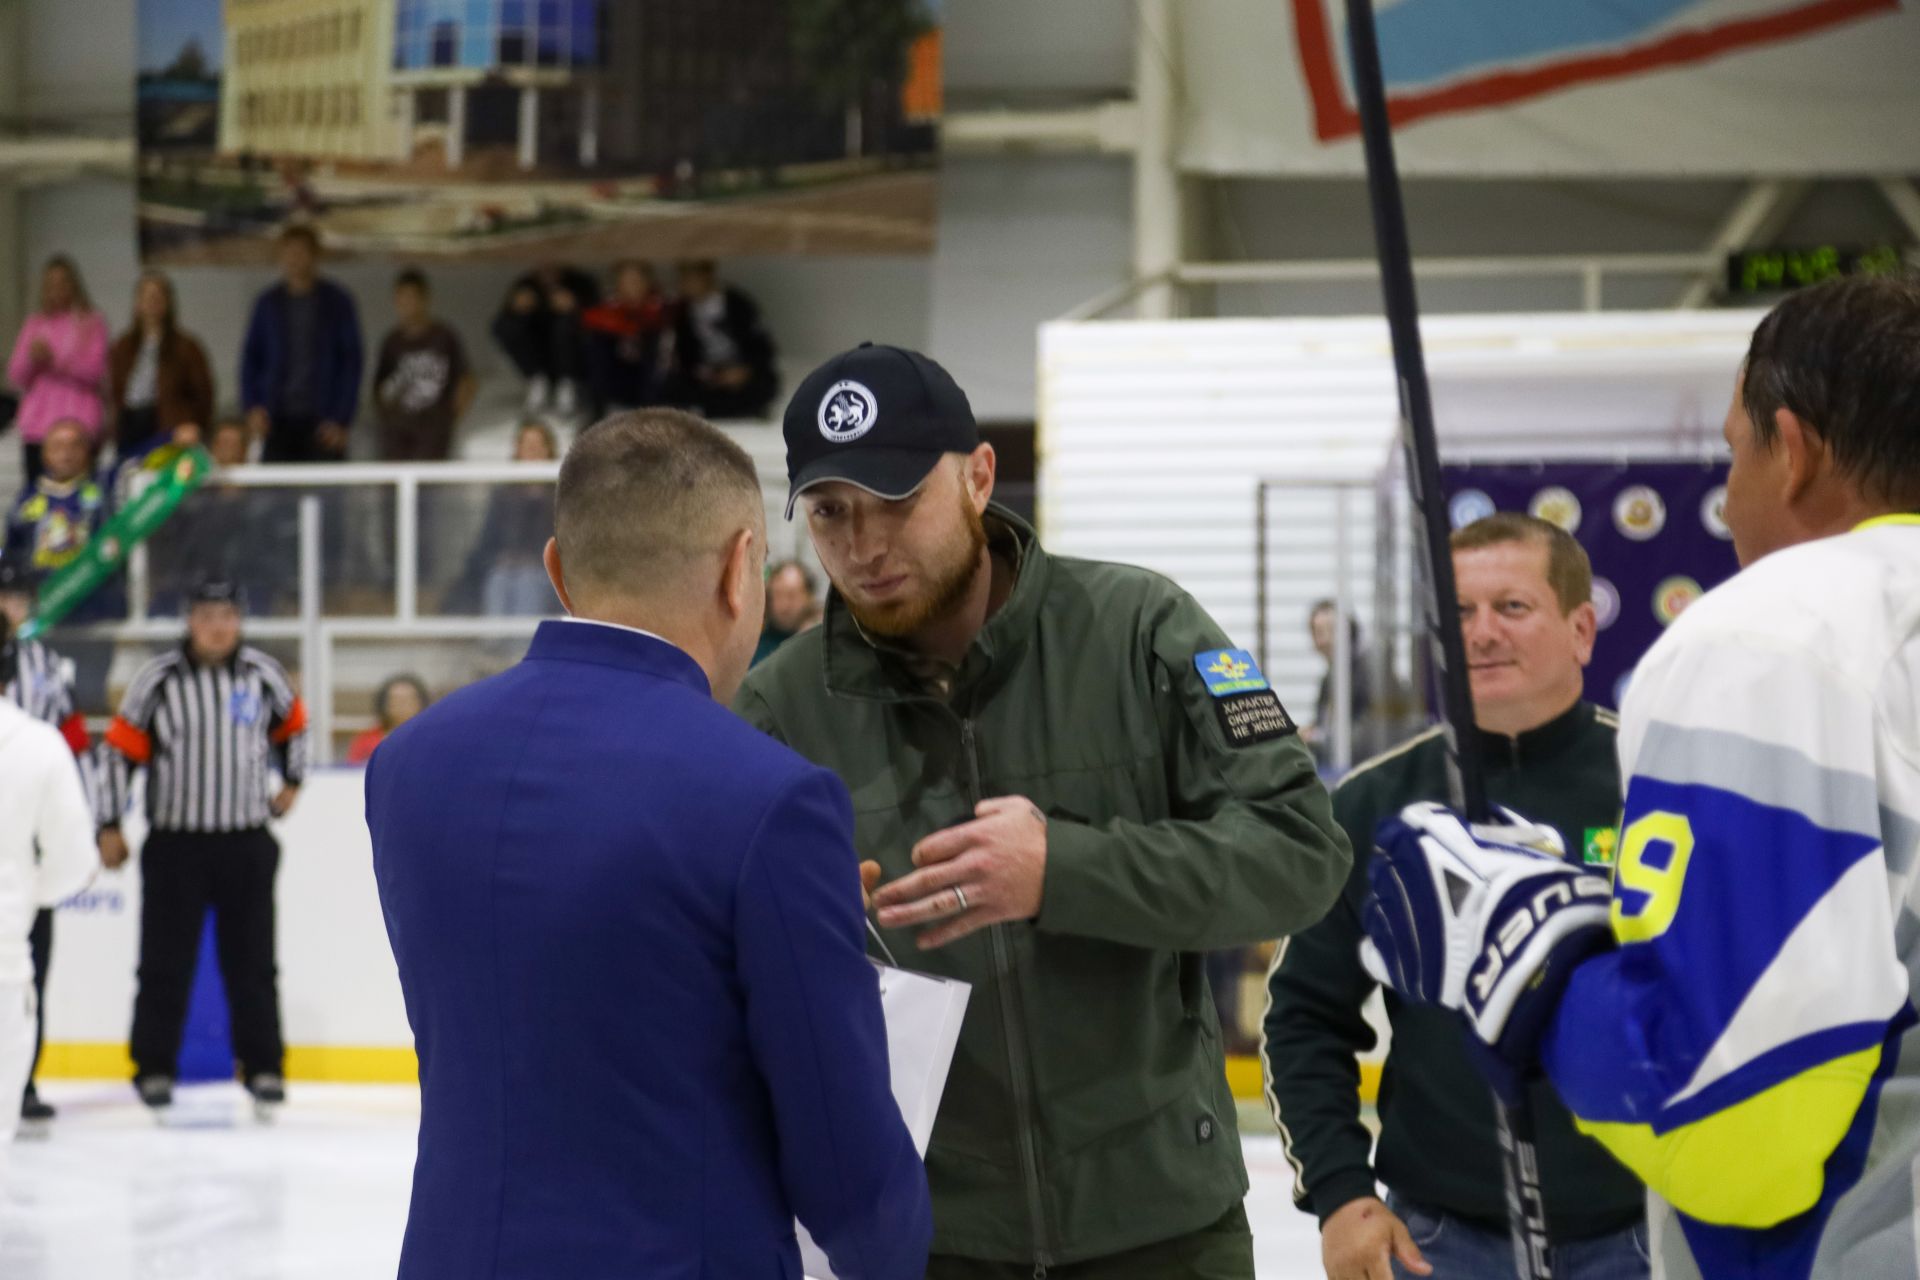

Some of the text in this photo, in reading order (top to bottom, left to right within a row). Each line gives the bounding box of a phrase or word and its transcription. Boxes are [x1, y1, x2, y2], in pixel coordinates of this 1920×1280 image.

[1222, 695, 1274, 715] ХАРАКТЕР
[1232, 717, 1287, 739] НЕ ЖЕНАТ
[1610, 809, 1695, 944] 9
[1473, 875, 1613, 1000] AUER
